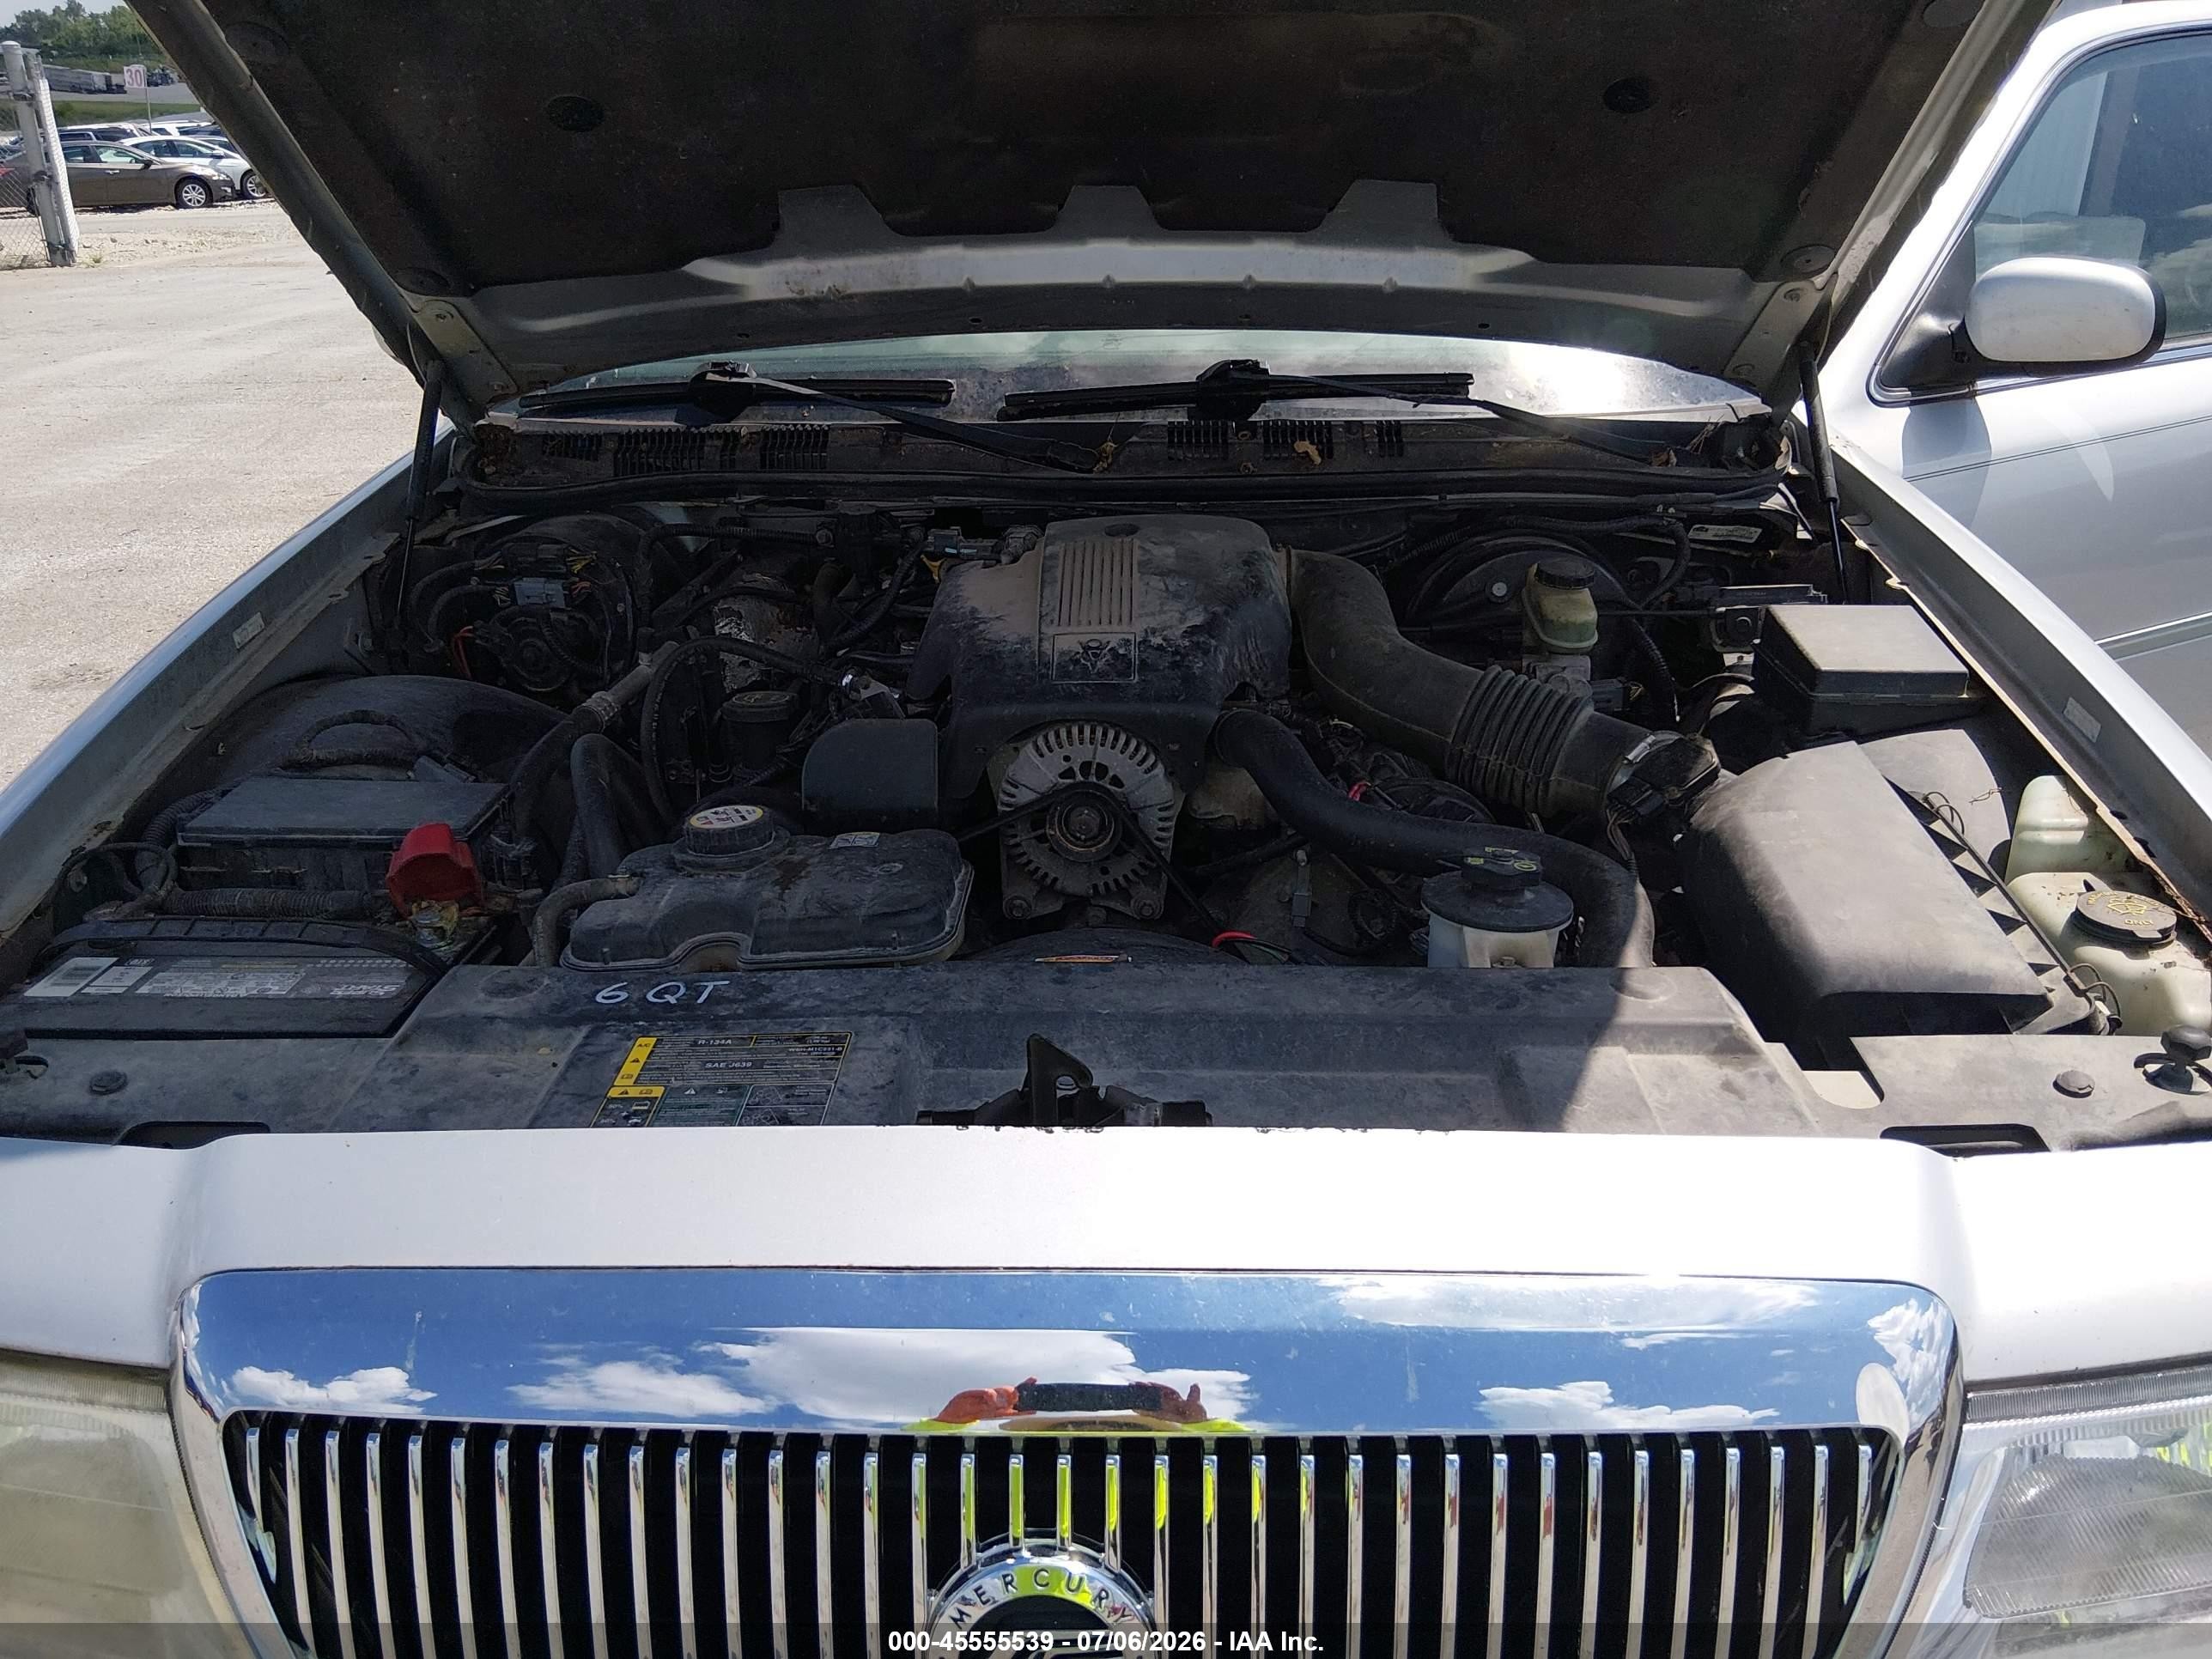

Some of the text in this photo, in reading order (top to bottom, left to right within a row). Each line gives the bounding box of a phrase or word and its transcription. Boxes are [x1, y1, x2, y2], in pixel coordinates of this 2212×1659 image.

[126, 69, 143, 87] 30
[595, 981, 730, 1004] 6 QT
[950, 1568, 1133, 1630] MERCURY
